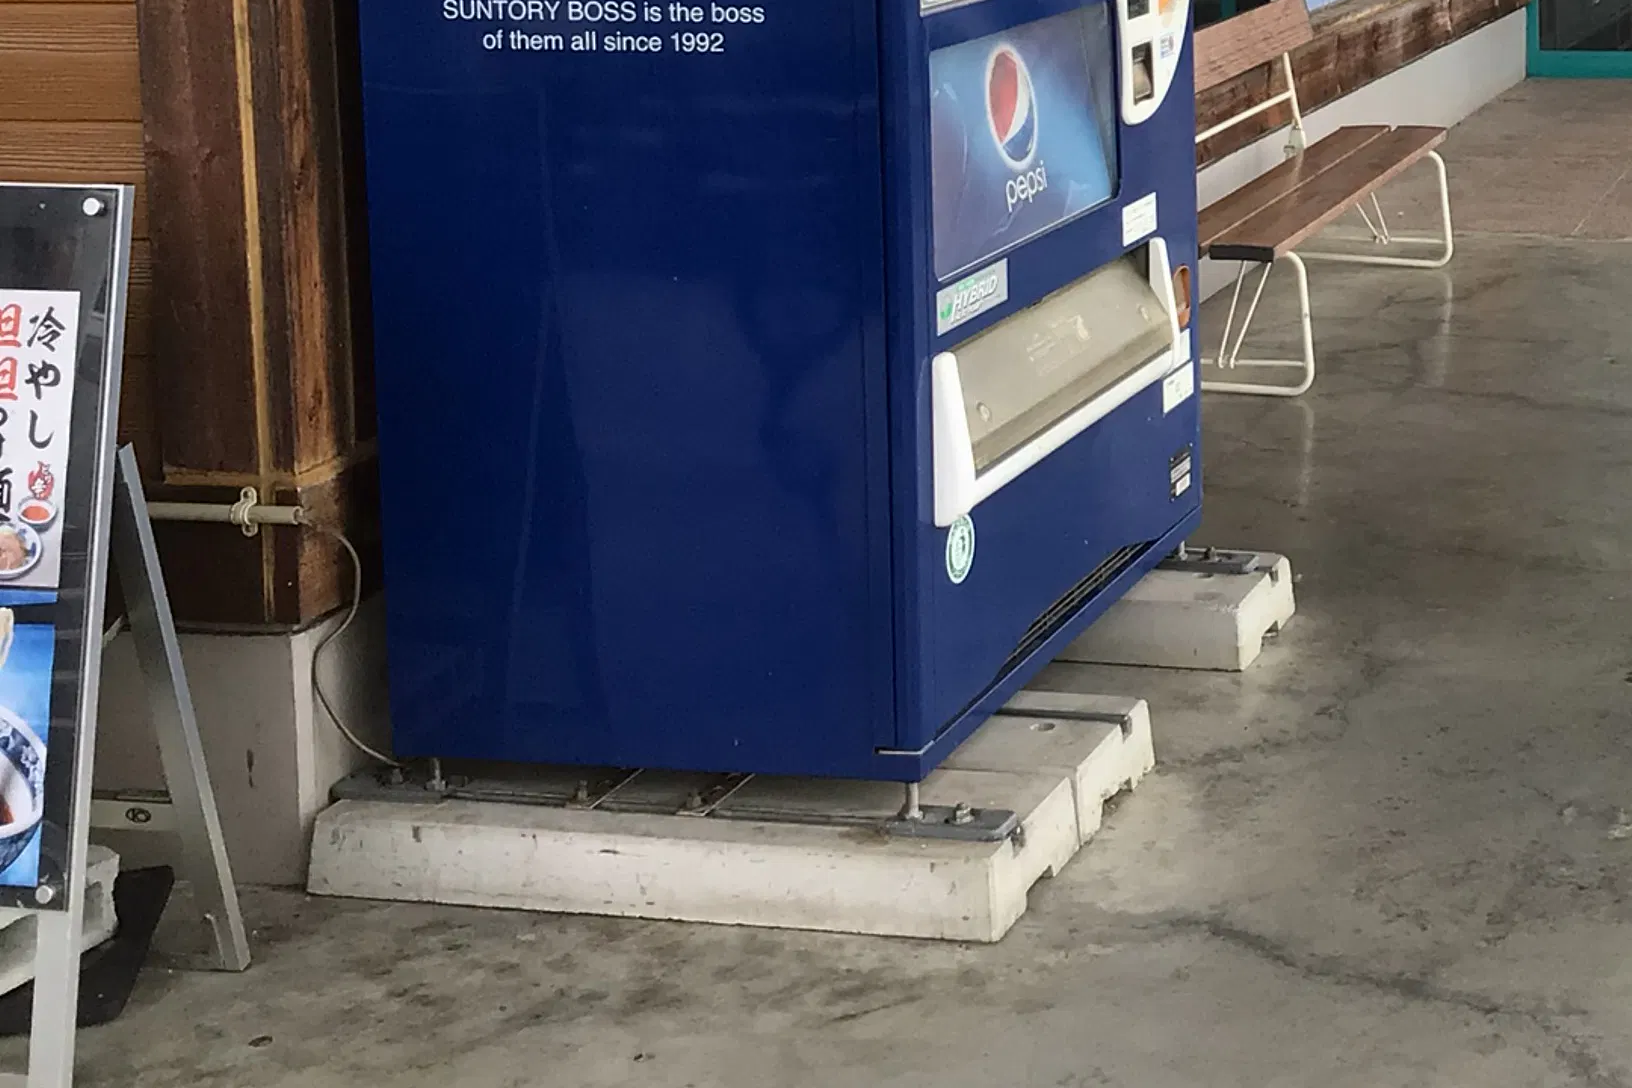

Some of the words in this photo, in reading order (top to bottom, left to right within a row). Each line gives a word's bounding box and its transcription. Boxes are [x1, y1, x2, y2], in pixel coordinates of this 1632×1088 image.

[567, 0, 637, 23] BOSS
[643, 1, 663, 23] is
[669, 1, 704, 23] the
[711, 2, 765, 24] boss
[482, 29, 503, 50] of
[509, 29, 564, 51] them
[570, 30, 597, 51] all
[603, 30, 662, 52] since
[670, 32, 725, 53] 1992
[1005, 159, 1048, 213] pepsi
[951, 275, 998, 324] HYBRID
[25, 306, 66, 449] 冷やし
